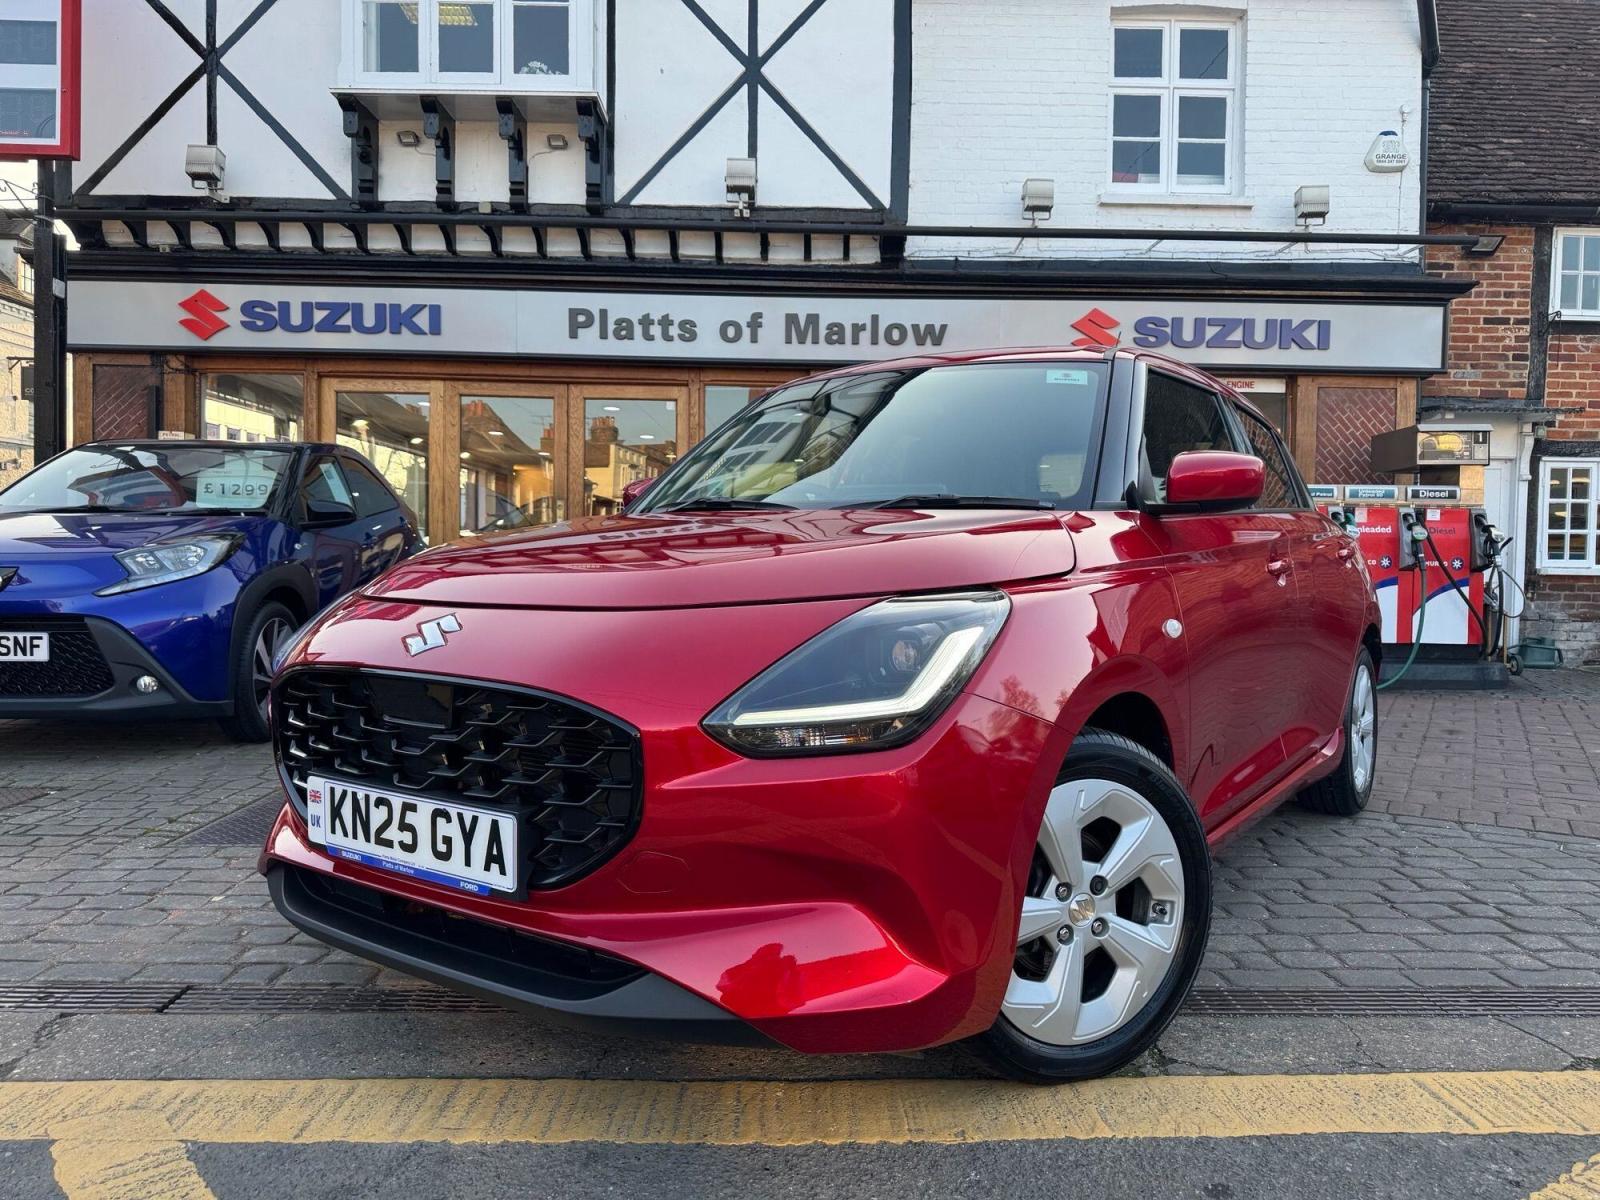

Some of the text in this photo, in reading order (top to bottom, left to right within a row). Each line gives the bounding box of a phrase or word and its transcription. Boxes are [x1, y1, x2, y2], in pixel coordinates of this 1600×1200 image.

[240, 300, 441, 336] SUZUKI
[568, 308, 949, 346] Platts of Marlow
[1133, 316, 1331, 350] SUZUKI
[1226, 381, 1255, 389] ENGINE
[1419, 490, 1449, 498] Diesel
[1429, 526, 1456, 534] Diesel
[0, 636, 43, 656] SNF
[310, 814, 321, 829] UK
[329, 786, 507, 876] KN25 GYA
[341, 850, 362, 861] SUZUKI
[460, 881, 479, 892] FORD
